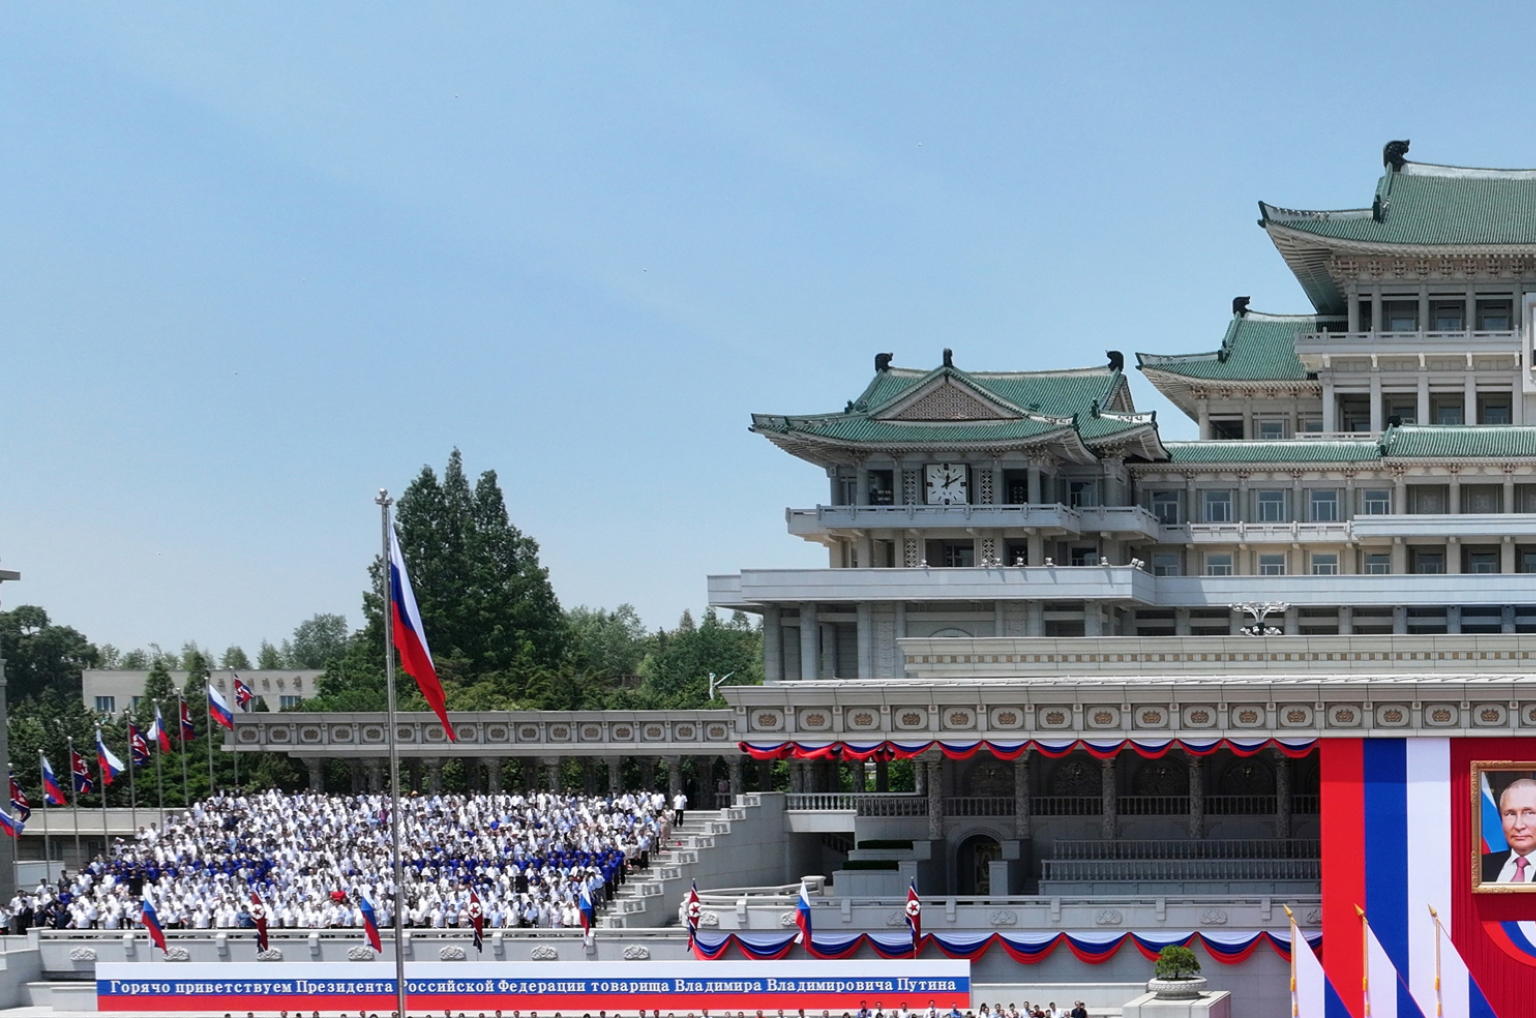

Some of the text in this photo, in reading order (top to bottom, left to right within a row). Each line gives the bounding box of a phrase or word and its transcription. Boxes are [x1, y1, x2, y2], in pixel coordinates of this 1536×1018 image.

[110, 980, 171, 995] Горячо
[175, 982, 292, 995] приветствуем
[296, 980, 394, 995] Президента
[498, 979, 586, 994] Федерации
[591, 981, 670, 993] товарища
[675, 978, 762, 993] Владимира
[767, 978, 894, 993] Владимировича
[897, 977, 957, 993] Путина
